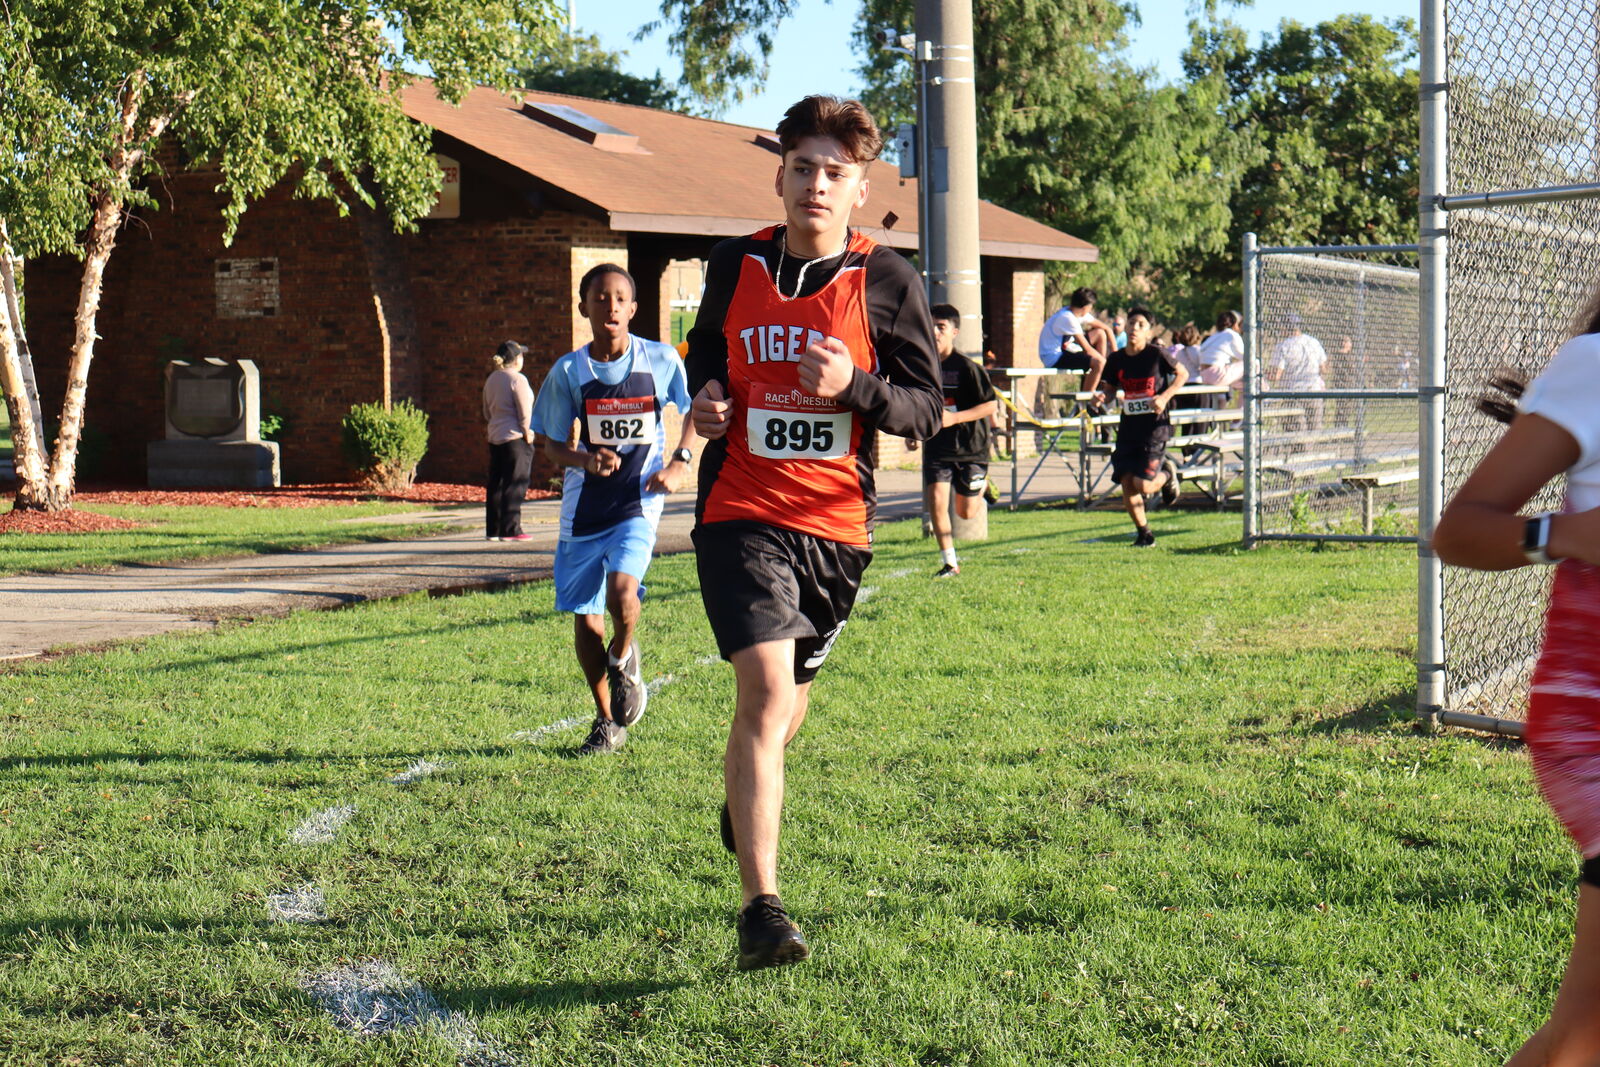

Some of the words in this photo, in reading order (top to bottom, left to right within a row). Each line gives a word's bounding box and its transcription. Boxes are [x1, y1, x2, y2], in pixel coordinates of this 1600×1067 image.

[765, 392, 790, 404] RACE
[596, 403, 614, 411] RACE
[1128, 400, 1149, 412] 835
[600, 418, 644, 439] 862
[765, 418, 834, 452] 895
